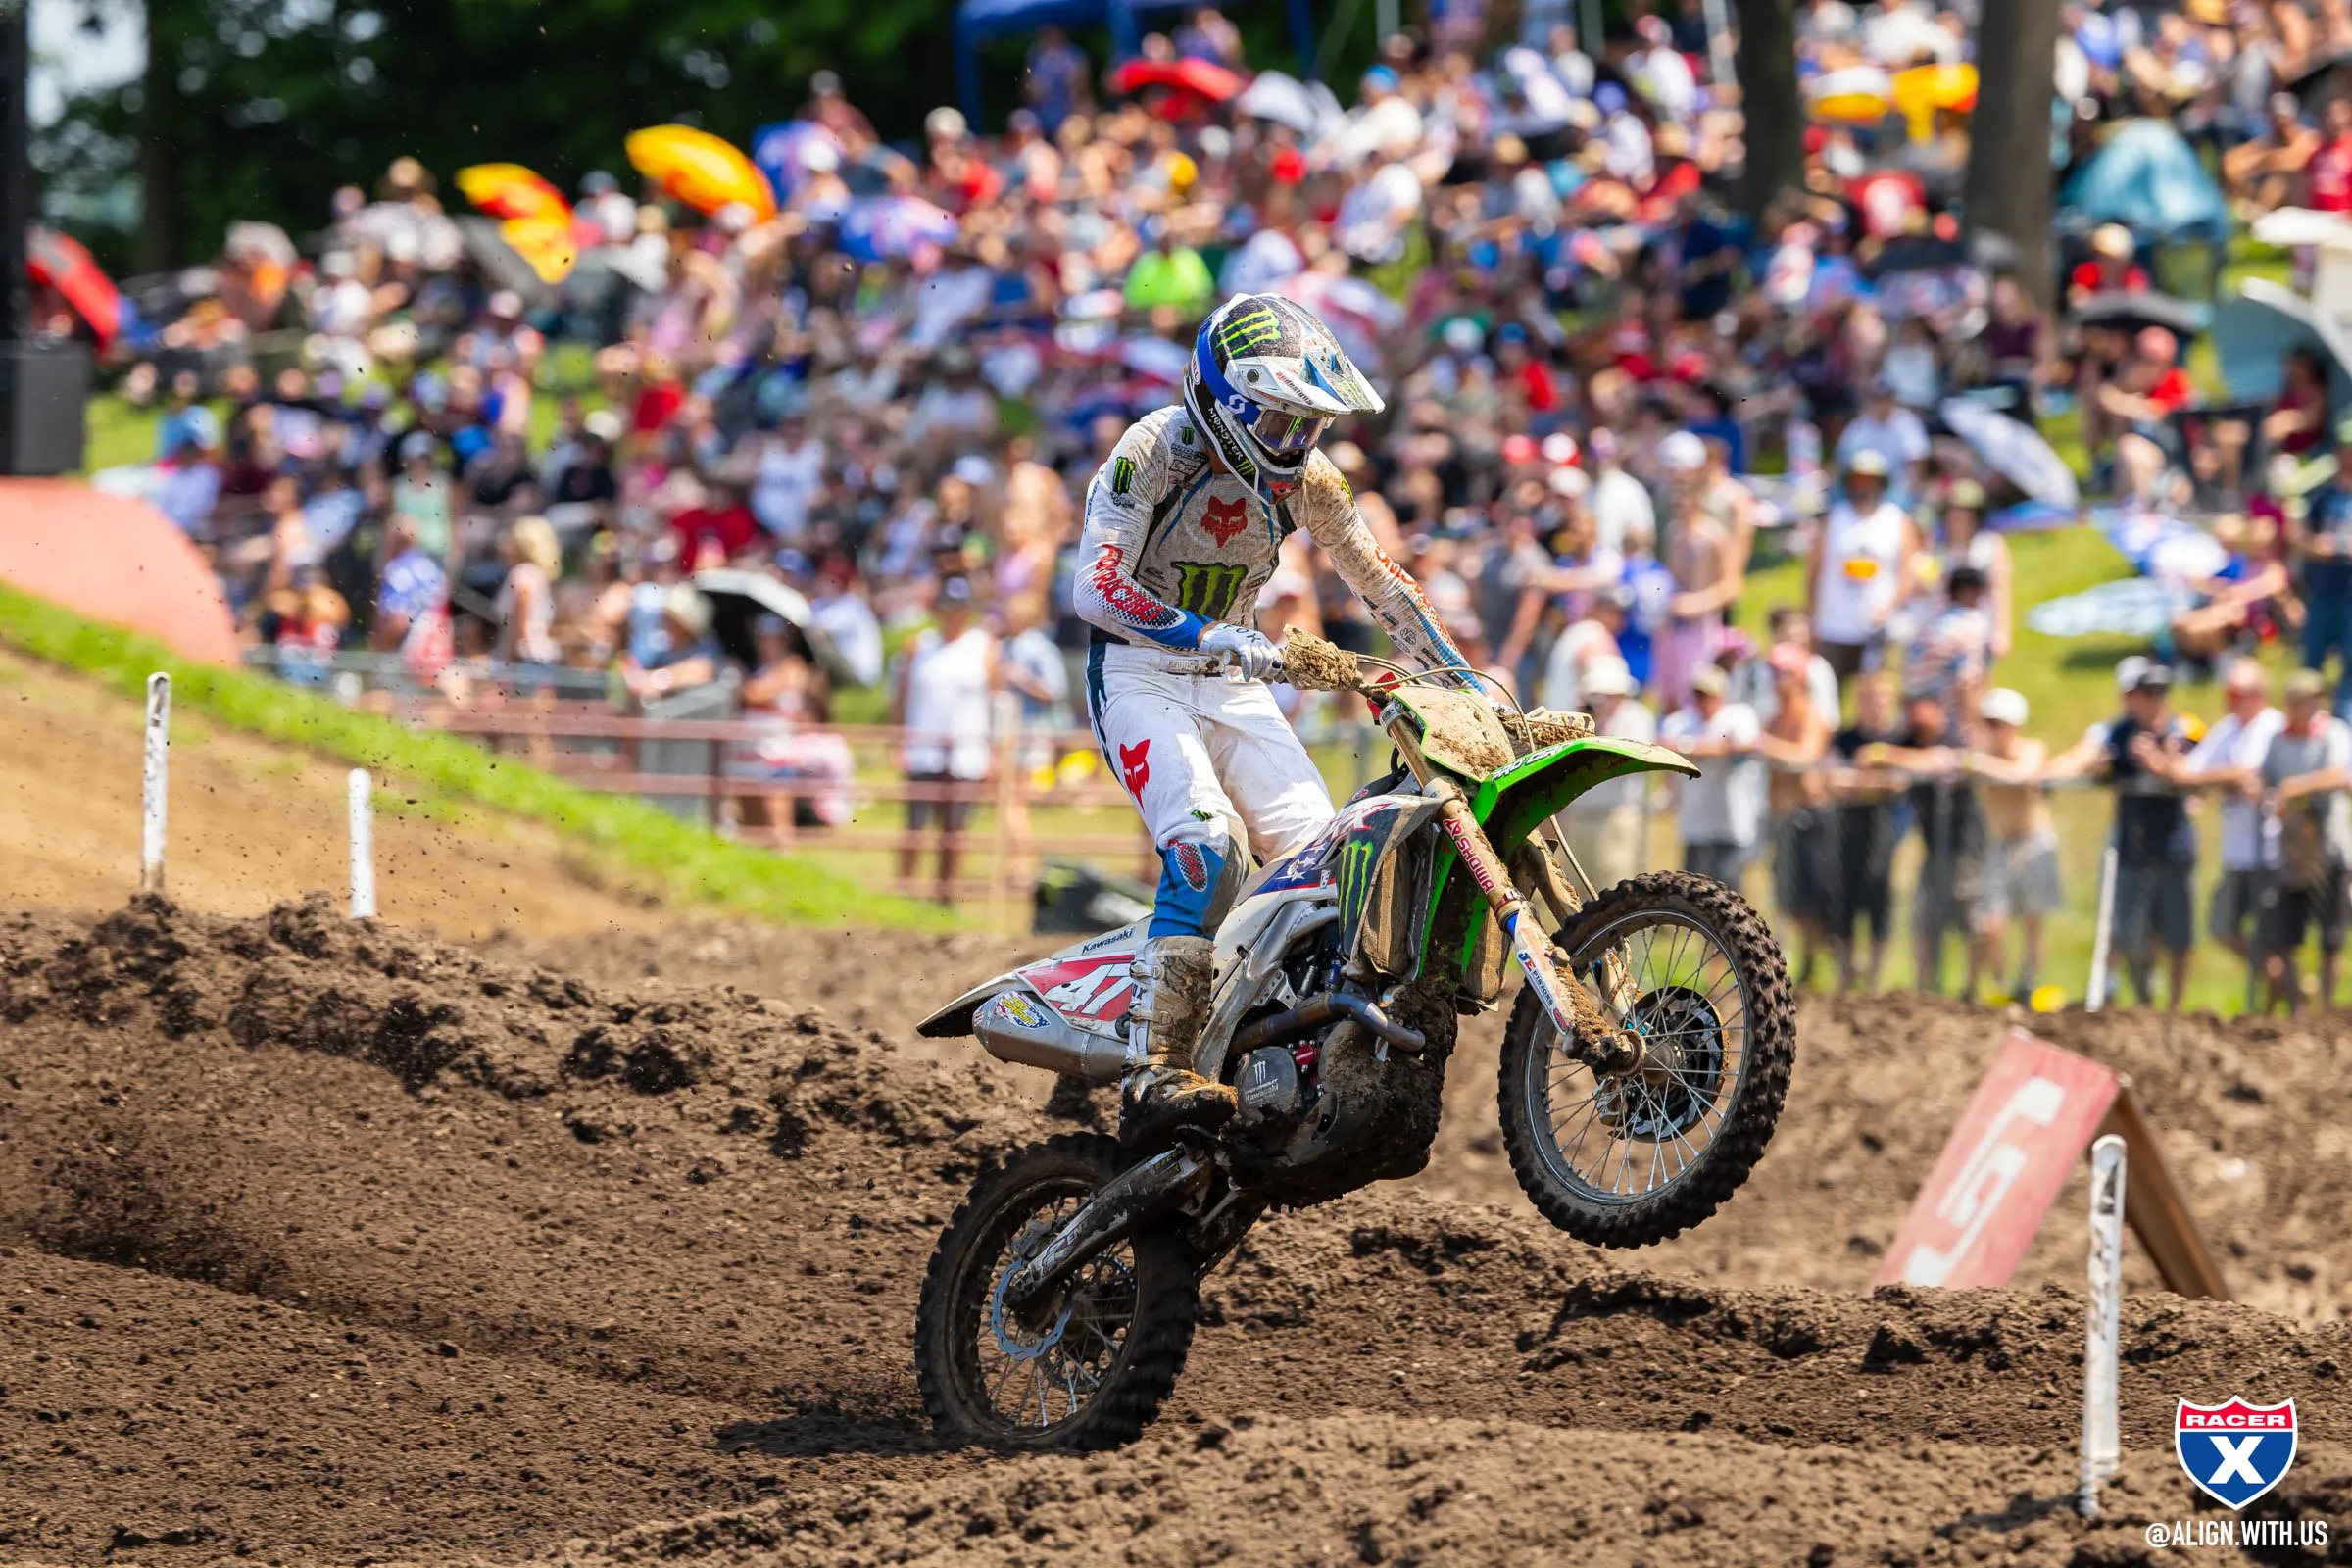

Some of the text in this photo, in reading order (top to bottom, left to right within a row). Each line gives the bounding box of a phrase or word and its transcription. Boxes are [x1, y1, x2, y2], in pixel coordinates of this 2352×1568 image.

[1208, 407, 1244, 461] MONSTER
[1491, 757, 1526, 784] PRO
[1455, 835, 1497, 895] SHOWA
[1081, 927, 1135, 955] Kawasaki
[1044, 962, 1133, 1015] 47
[1517, 952, 1554, 1007] JE PISTONS
